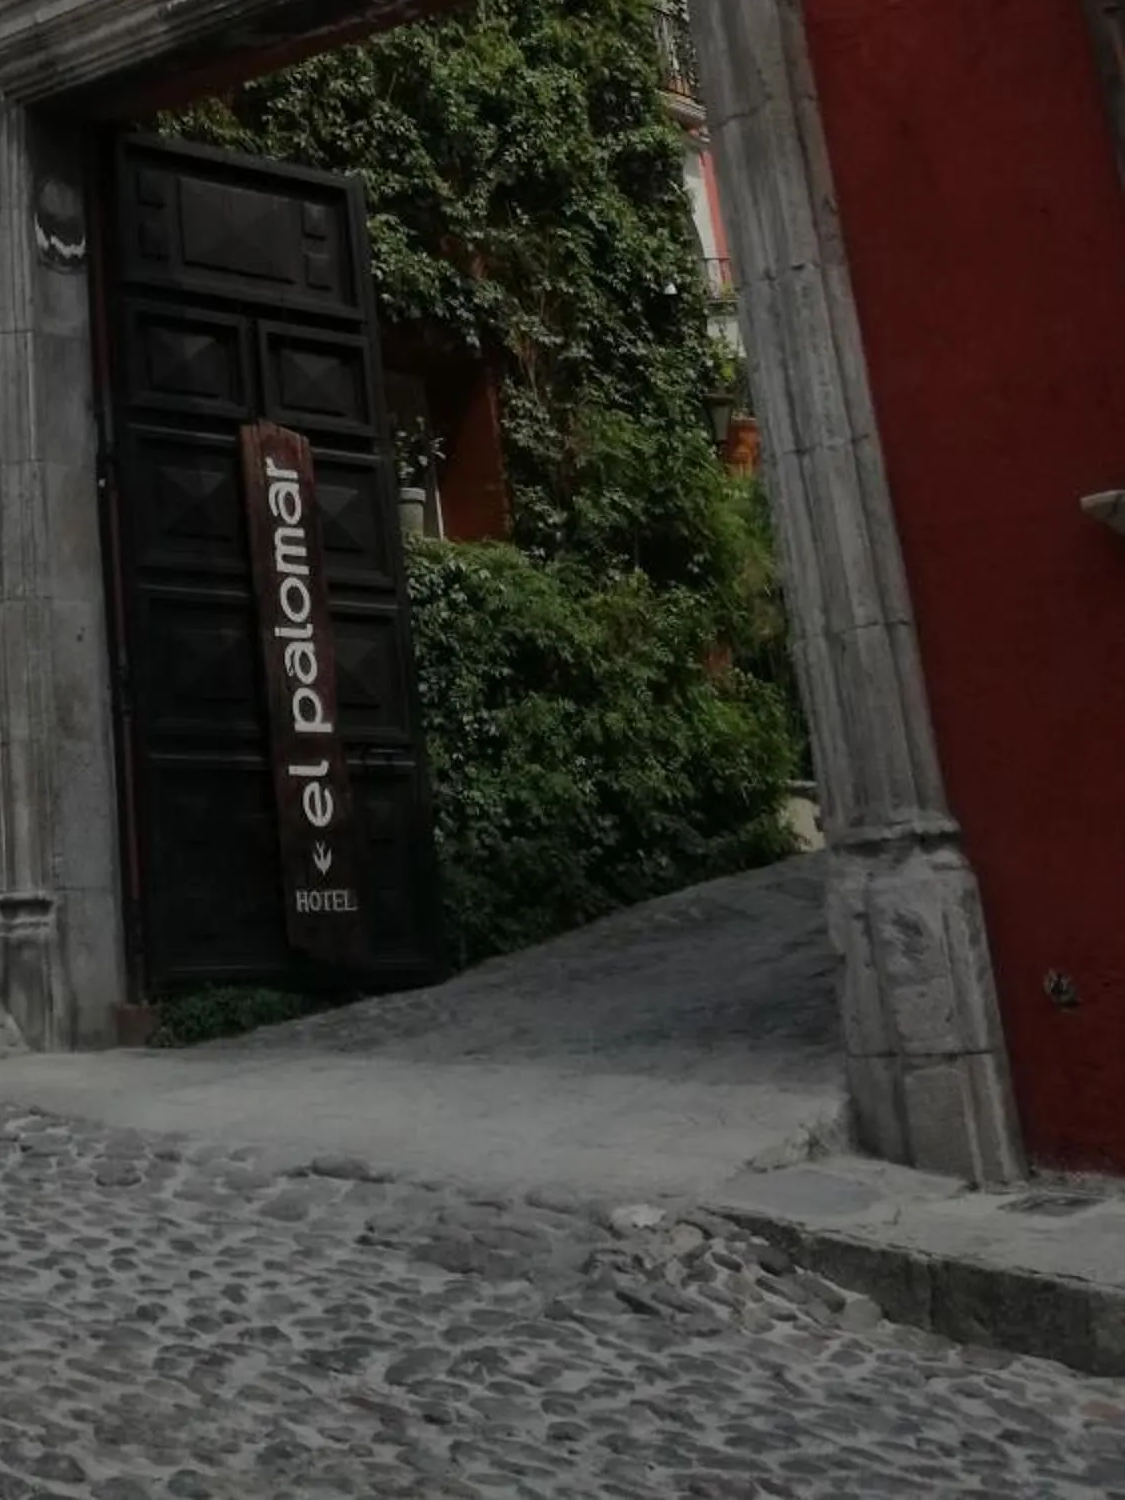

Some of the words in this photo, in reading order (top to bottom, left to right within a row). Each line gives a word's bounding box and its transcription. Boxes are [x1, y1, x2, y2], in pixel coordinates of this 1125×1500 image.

[265, 456, 334, 733] palomar
[288, 758, 333, 827] el
[296, 889, 358, 913] HOTEL
